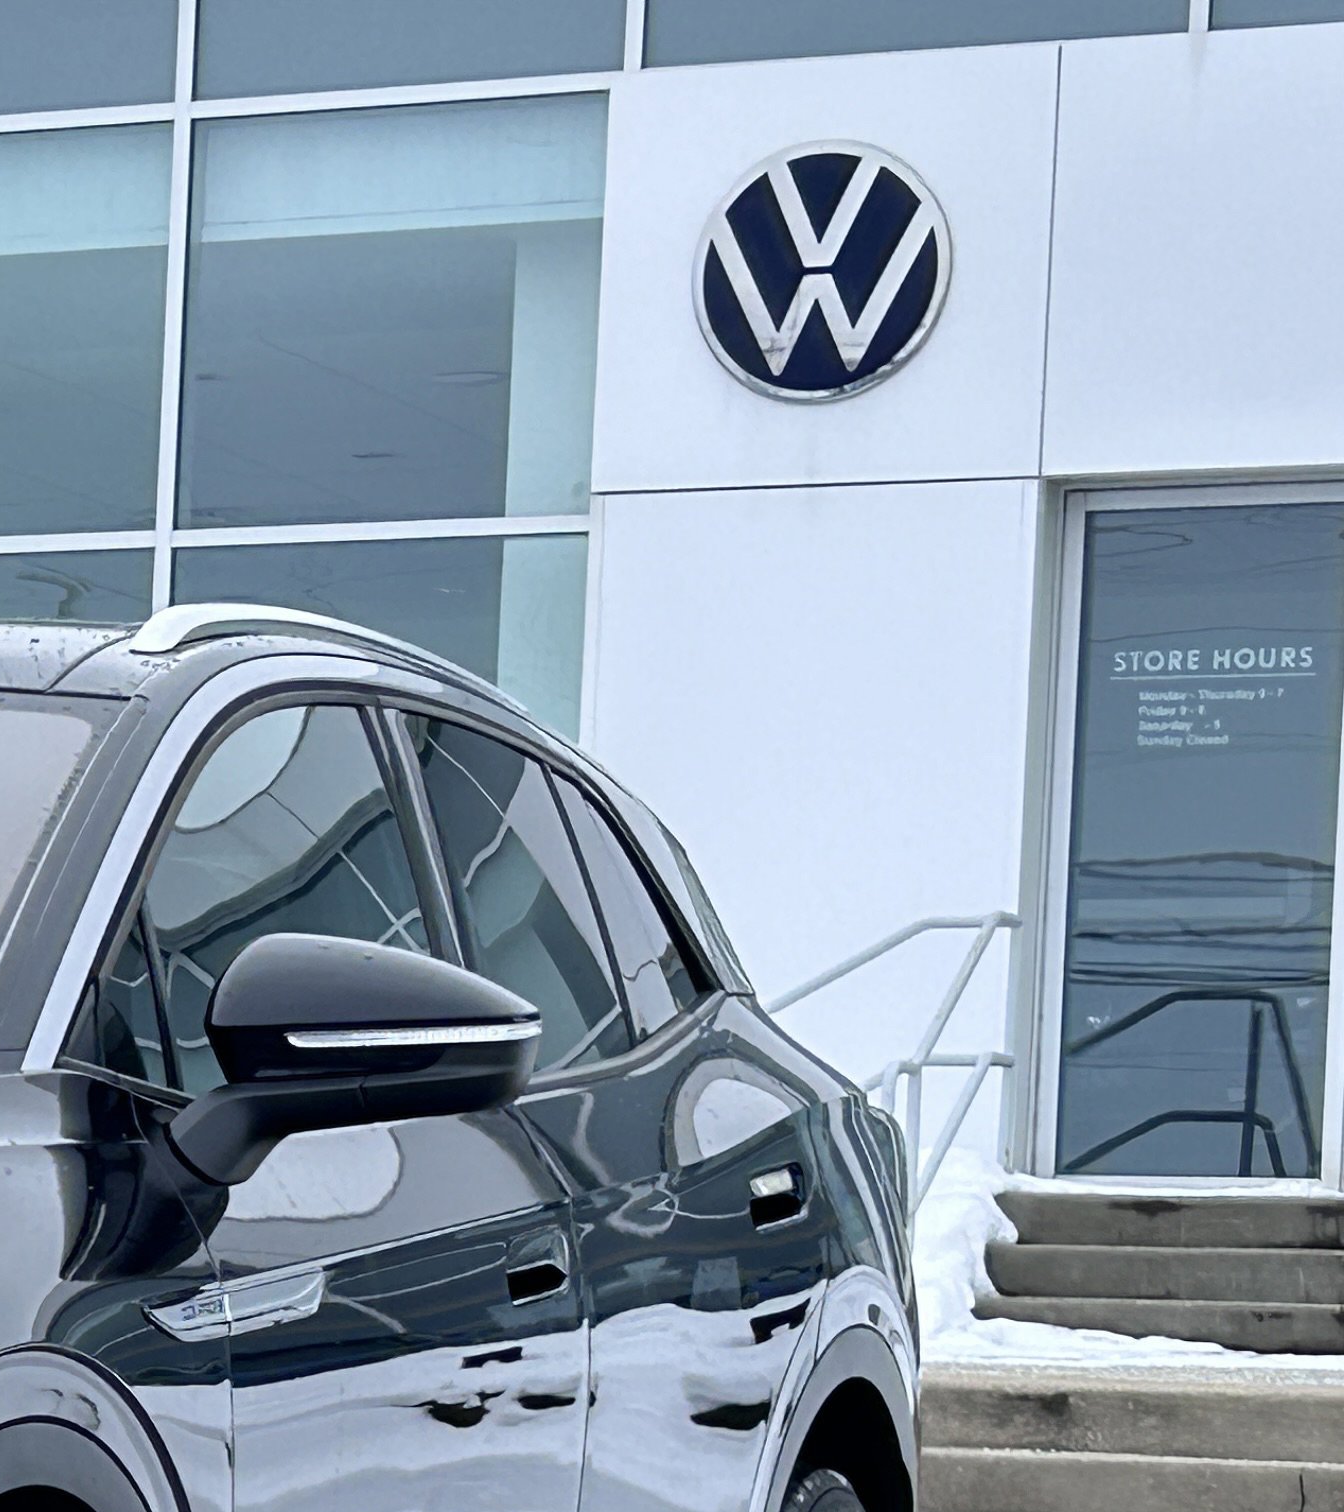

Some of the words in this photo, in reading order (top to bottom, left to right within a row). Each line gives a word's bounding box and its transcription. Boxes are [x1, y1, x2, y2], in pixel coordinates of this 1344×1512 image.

[700, 146, 942, 380] VW
[1113, 649, 1201, 672] STORE
[1213, 646, 1313, 671] HOURS
